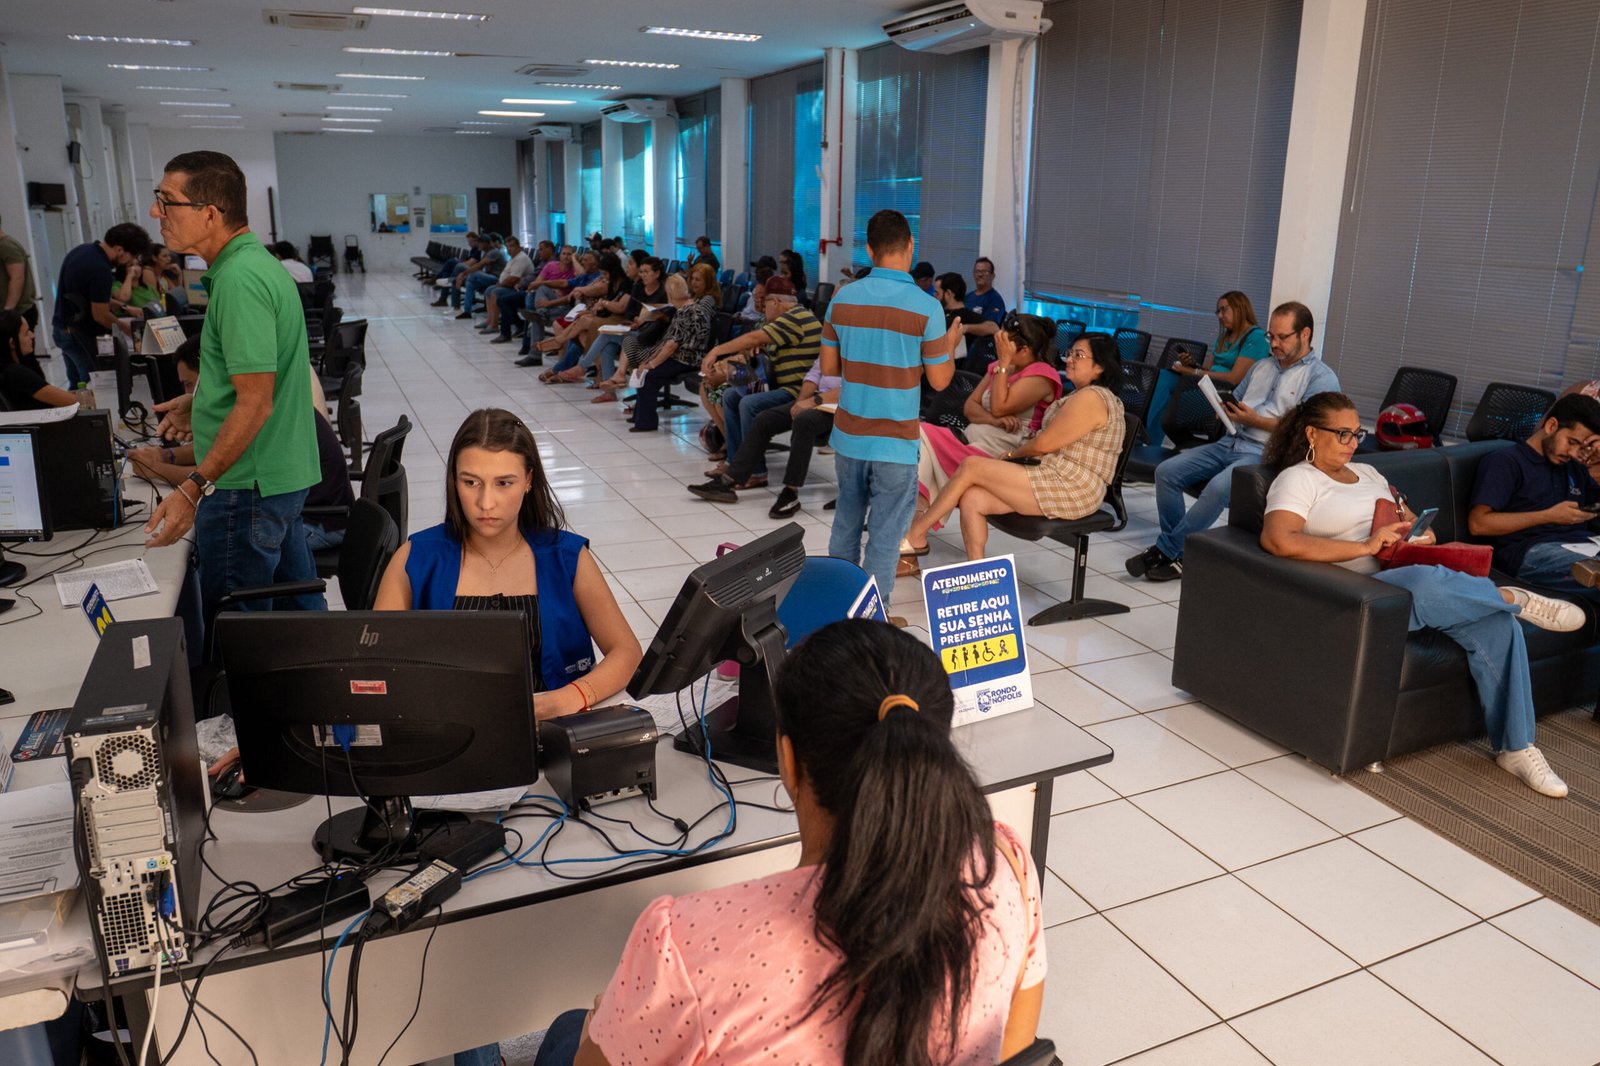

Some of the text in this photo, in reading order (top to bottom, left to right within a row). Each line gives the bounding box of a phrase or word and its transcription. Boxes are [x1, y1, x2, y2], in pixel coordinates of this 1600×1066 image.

[932, 568, 1007, 590] ATENDIMENTO
[937, 595, 1010, 619] RETIRE AQUI
[939, 609, 1012, 634] SUA SENHA
[360, 624, 380, 648] hp
[940, 622, 1014, 646] PREFERÊNCIAL
[991, 685, 1017, 697] RONDO
